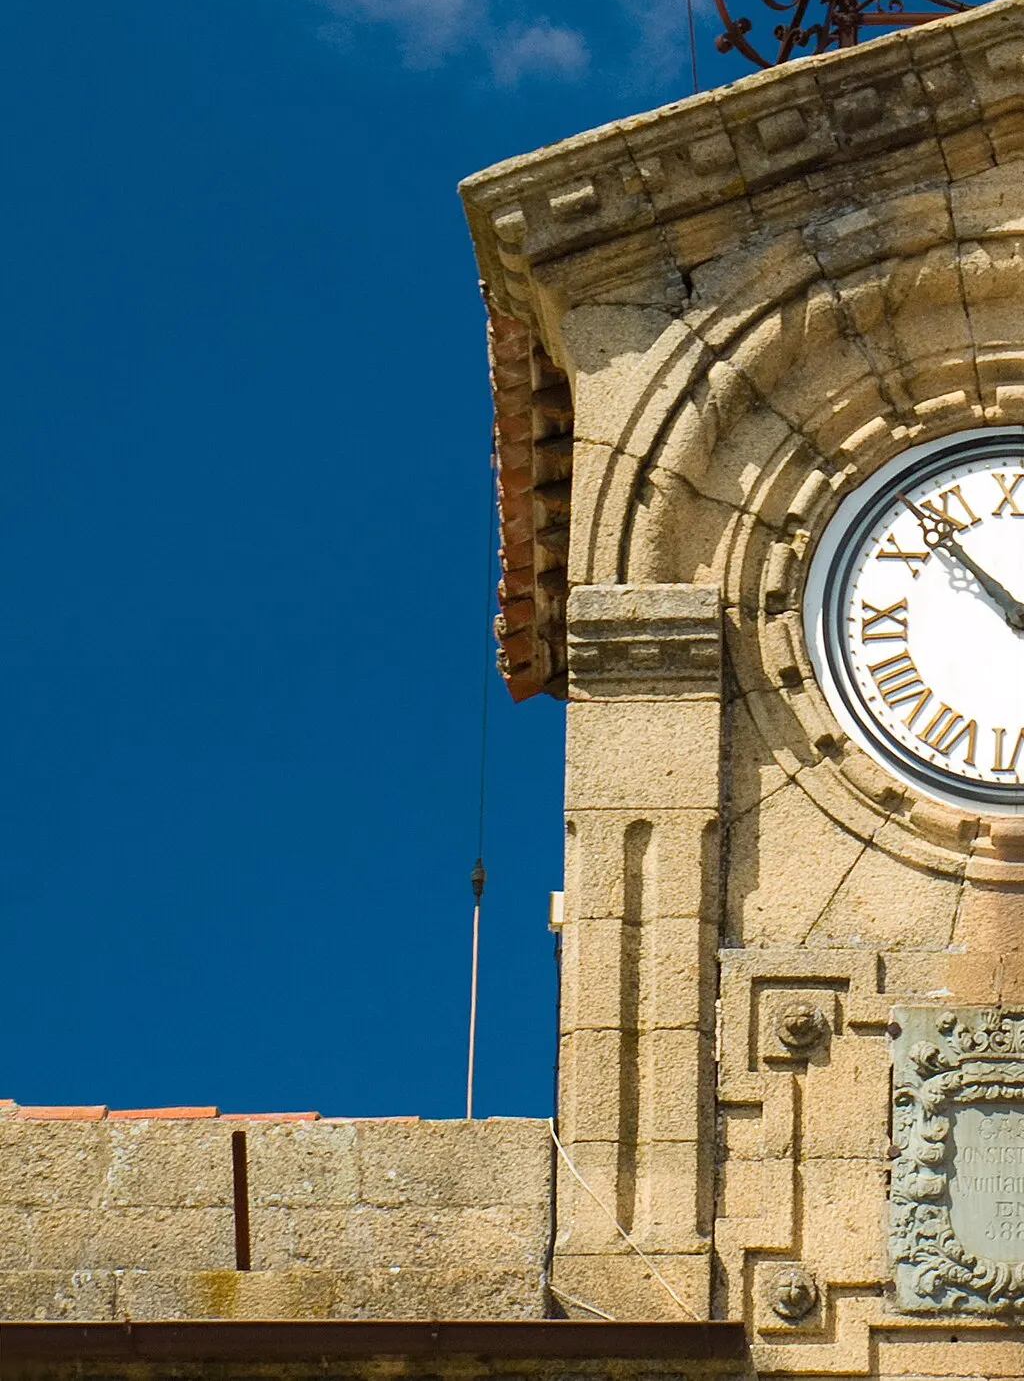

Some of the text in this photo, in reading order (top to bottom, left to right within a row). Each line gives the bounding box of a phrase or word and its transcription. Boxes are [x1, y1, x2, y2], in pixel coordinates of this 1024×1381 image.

[921, 485, 982, 533] XI
[876, 534, 930, 578] X
[862, 598, 908, 641] IX
[867, 650, 932, 729] VIII
[918, 702, 977, 766] VII
